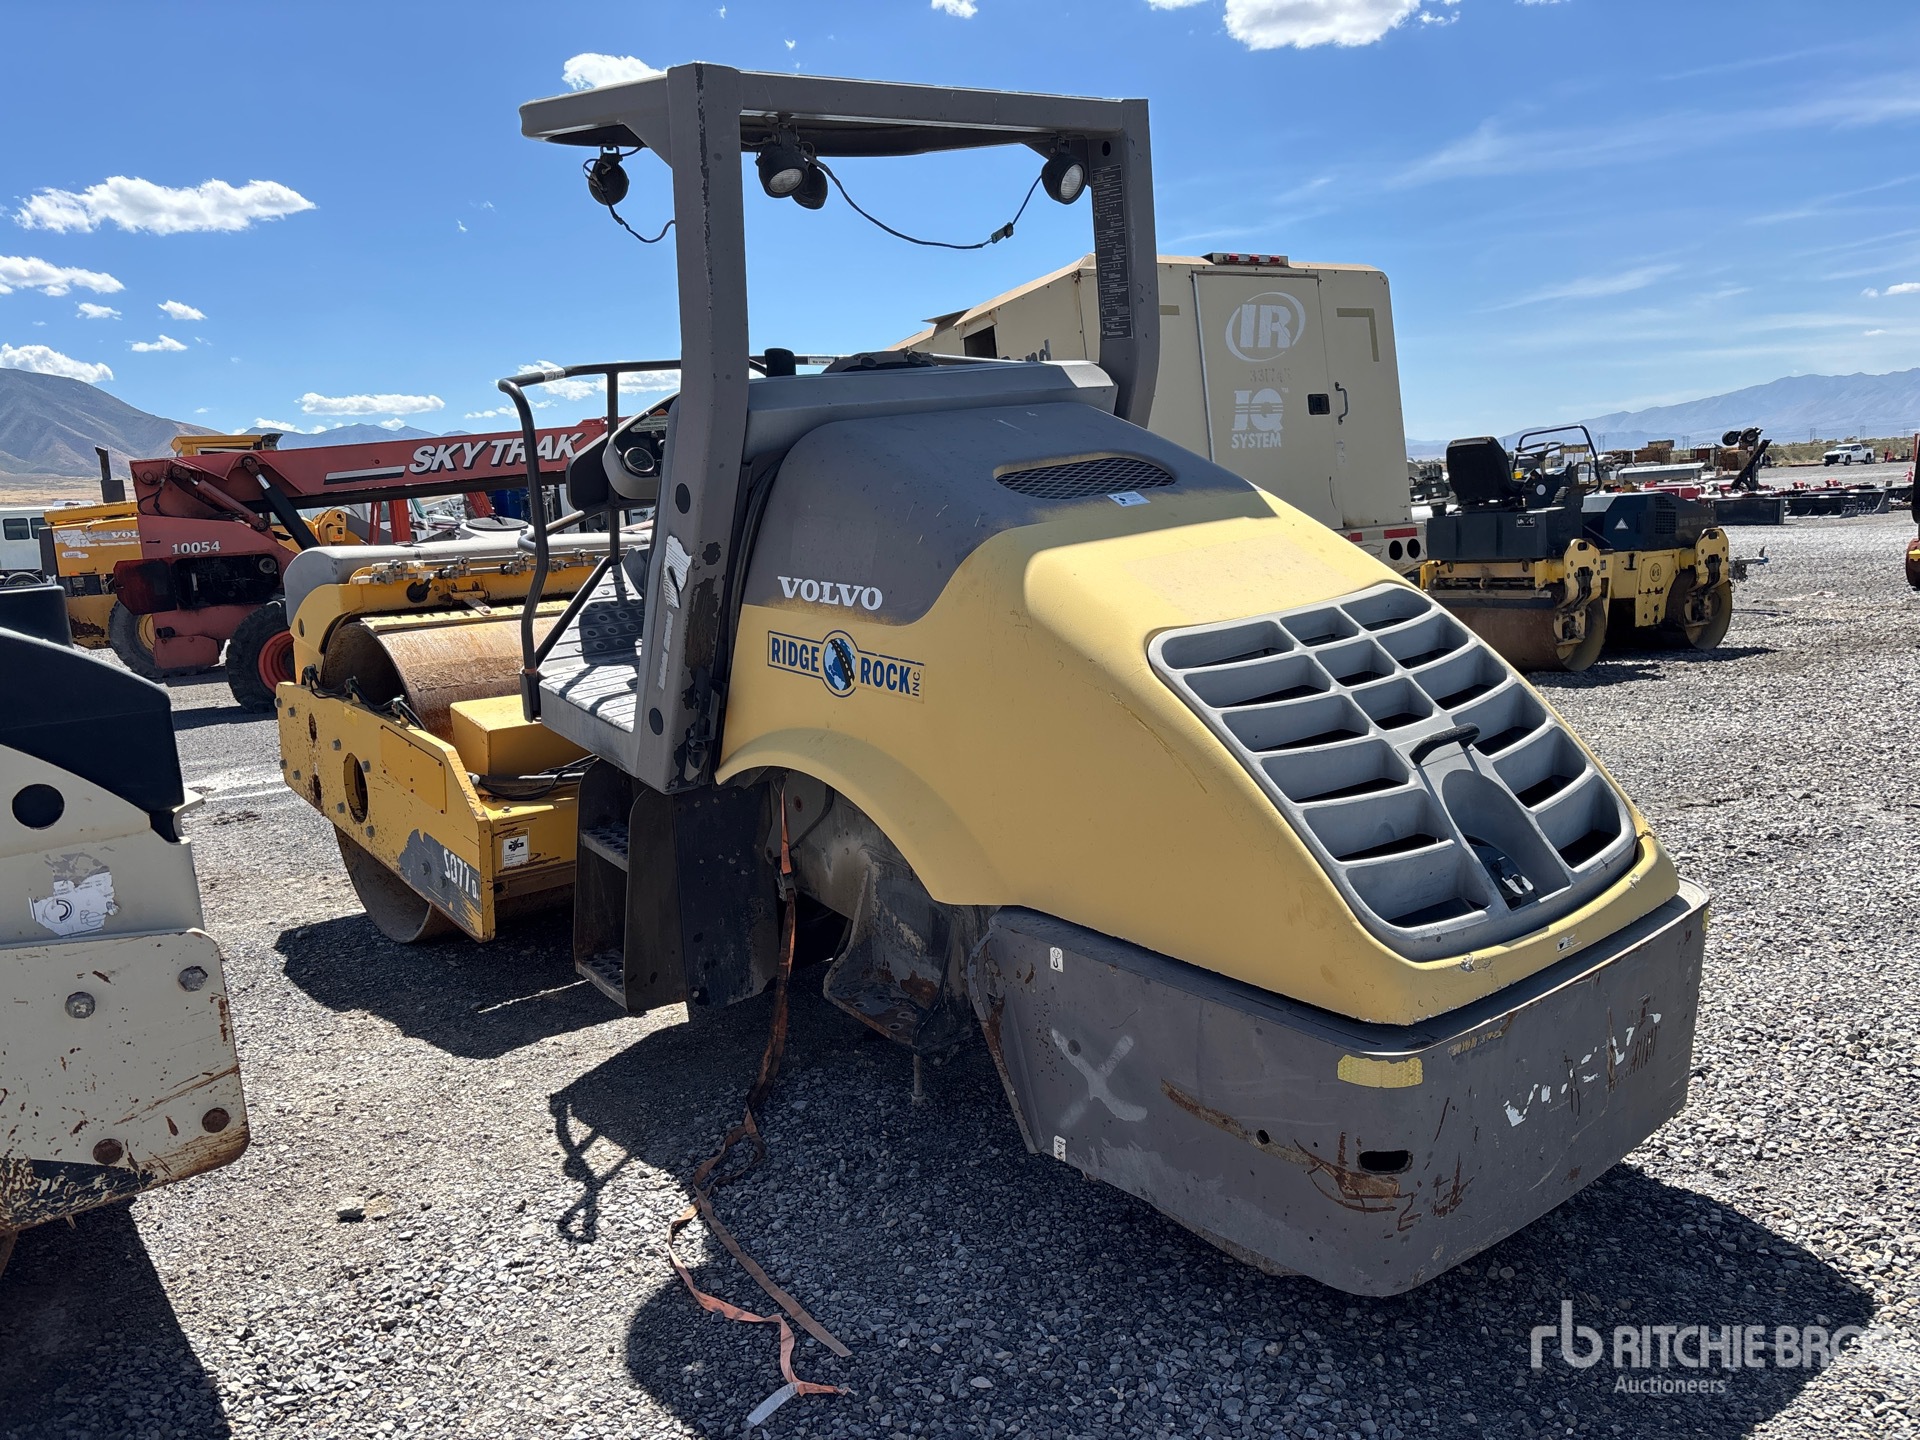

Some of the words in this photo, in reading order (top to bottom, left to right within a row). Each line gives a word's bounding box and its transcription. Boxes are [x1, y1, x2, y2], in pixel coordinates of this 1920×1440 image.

[1240, 304, 1291, 348] IR
[1232, 388, 1283, 432] IQ
[1231, 431, 1281, 448] SYSTEM
[409, 441, 488, 474] SKY
[172, 541, 221, 555] 10054
[777, 576, 883, 611] VOLVO
[771, 637, 820, 673] RIDGE
[860, 657, 911, 695] ROCK
